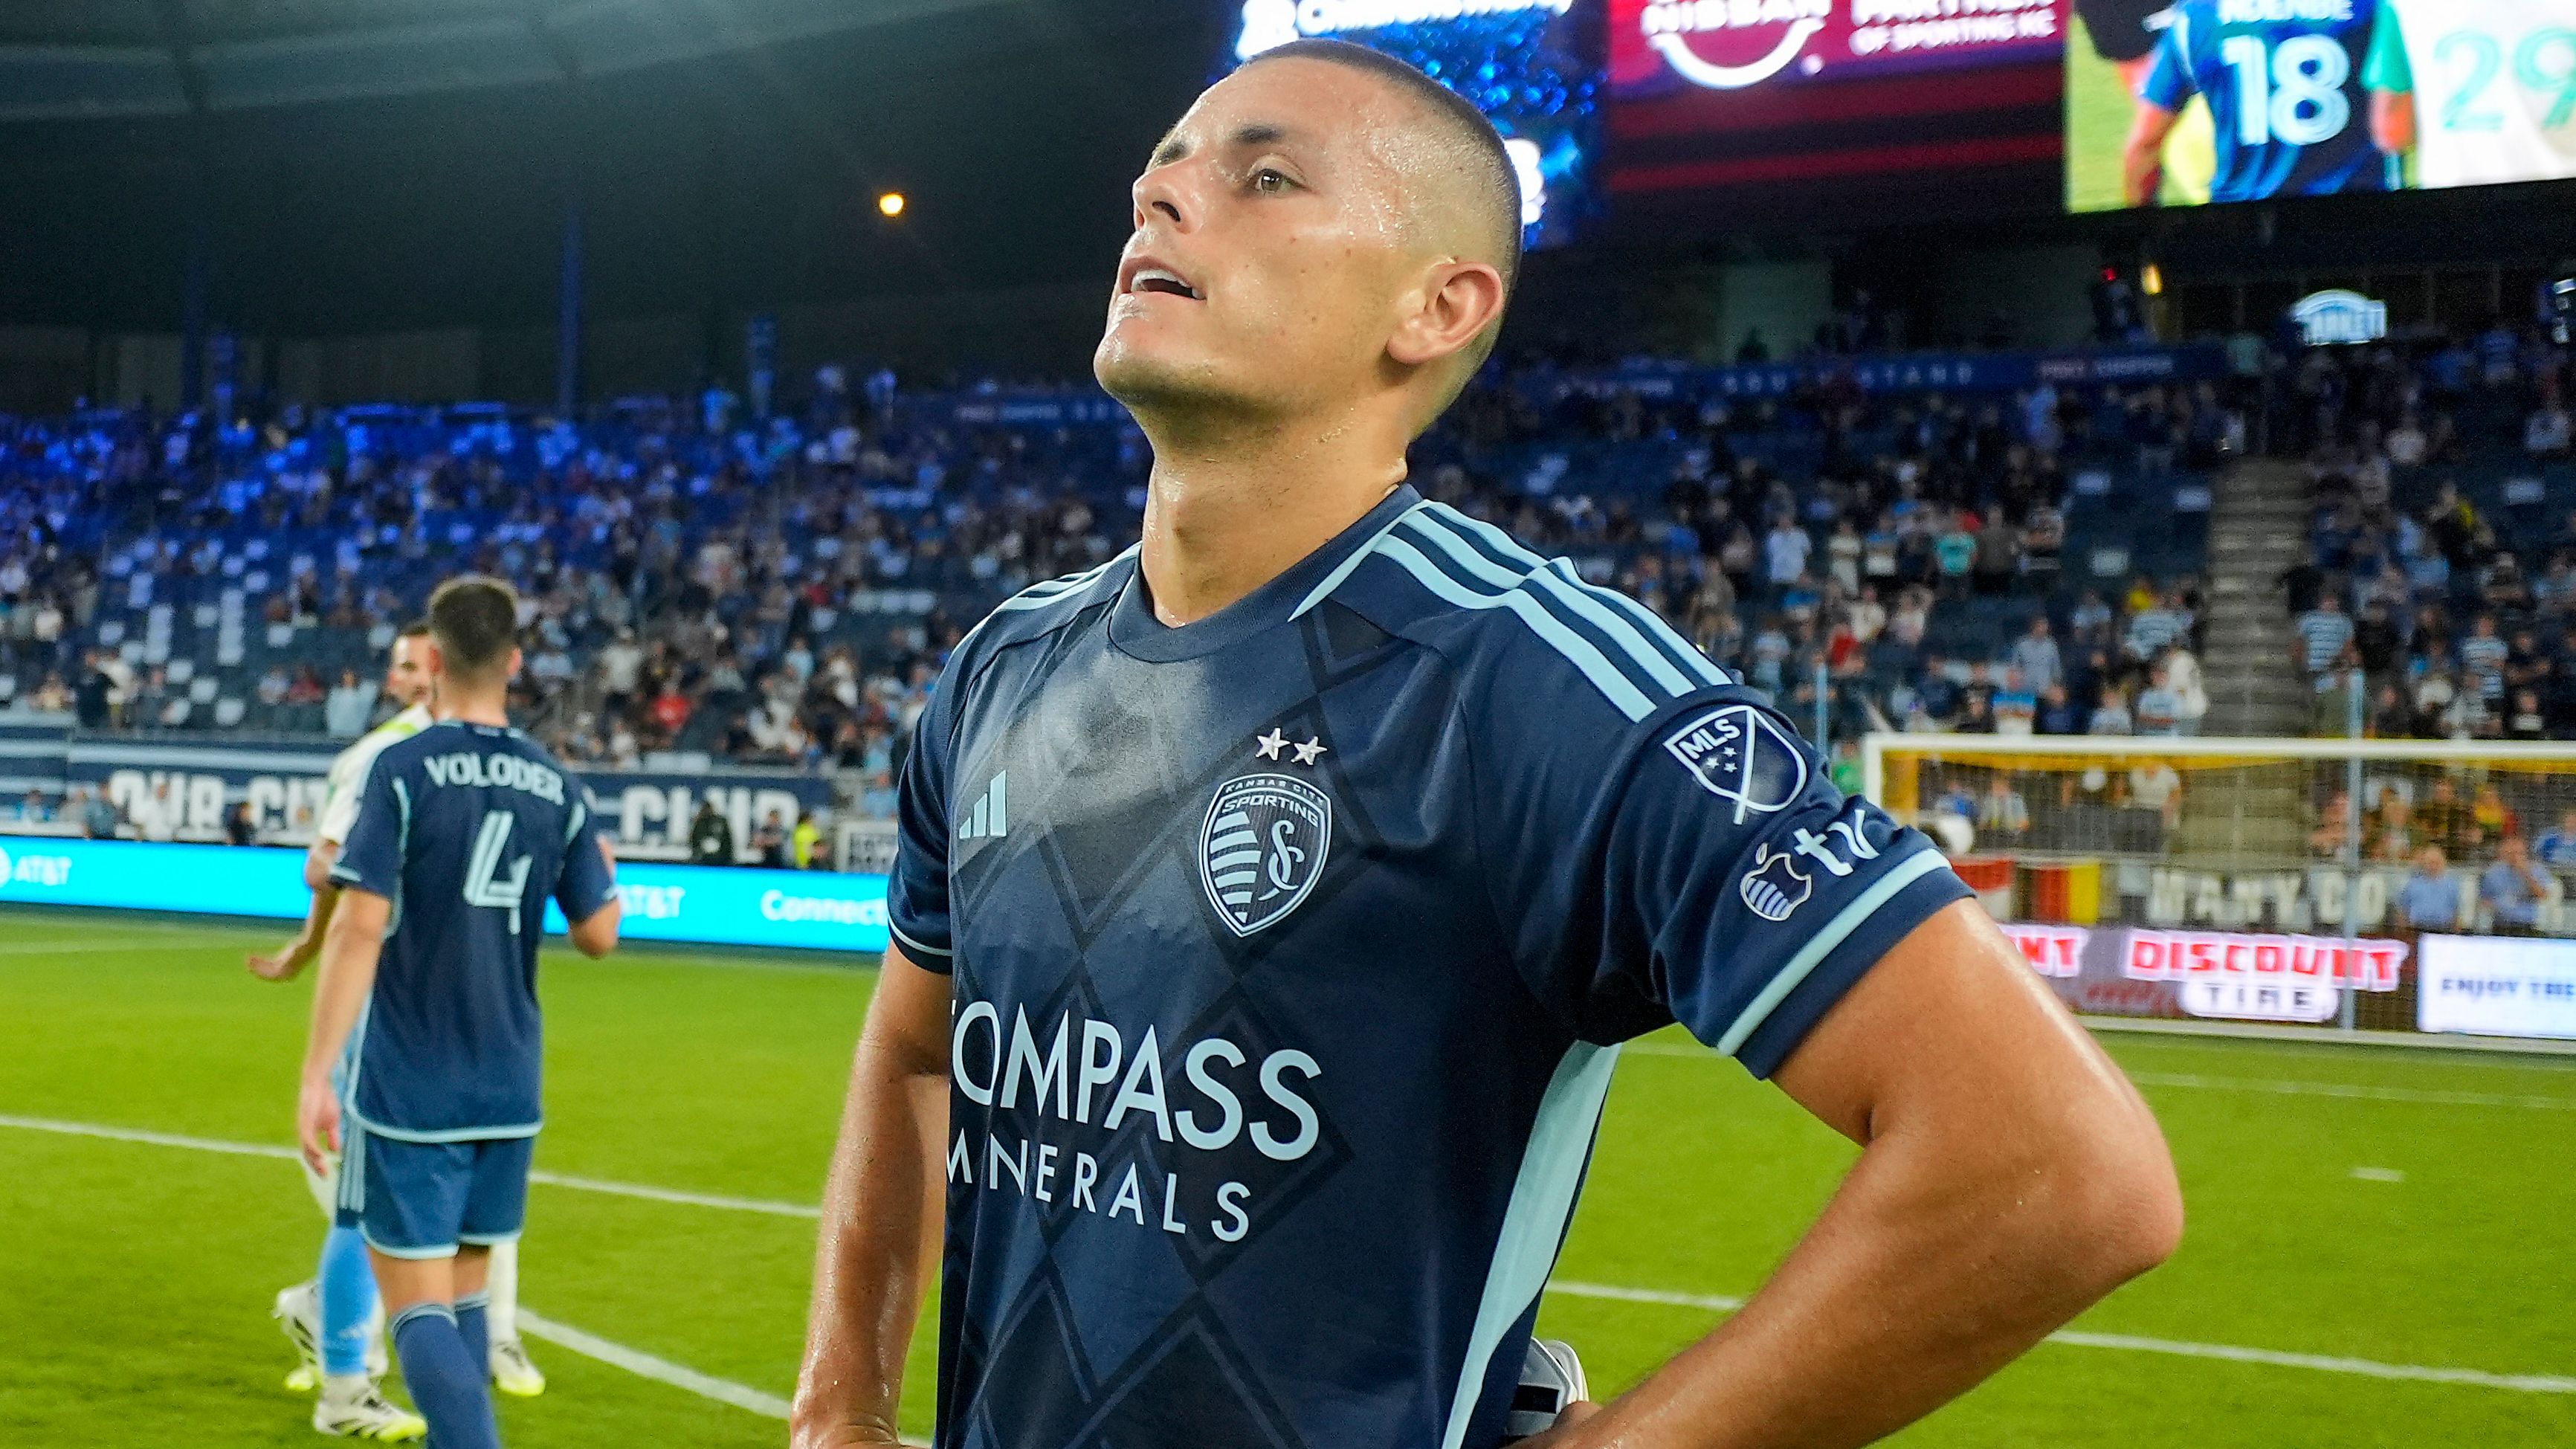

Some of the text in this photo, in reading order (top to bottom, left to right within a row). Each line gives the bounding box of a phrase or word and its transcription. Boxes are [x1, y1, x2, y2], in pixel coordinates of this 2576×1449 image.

[1850, 28, 1890, 55] OF
[1889, 15, 2015, 51] SPORTING
[2015, 8, 2056, 37] KC
[2220, 33, 2351, 146] 18
[2433, 29, 2576, 131] 29
[1679, 718, 1741, 761] MLS
[248, 775, 329, 831] CIT
[423, 751, 566, 806] VOLODER
[1224, 778, 1325, 804] KANSAS CITY
[1221, 794, 1320, 827] SPORTING
[15, 854, 73, 886] AT&T
[1793, 809, 1880, 877] tv
[462, 808, 533, 935] 4
[2126, 933, 2403, 989] DISCOUNT
[2207, 985, 2314, 1007] TIRE
[951, 999, 1323, 1161] OMPASS
[946, 1126, 1251, 1242] MNERALS
